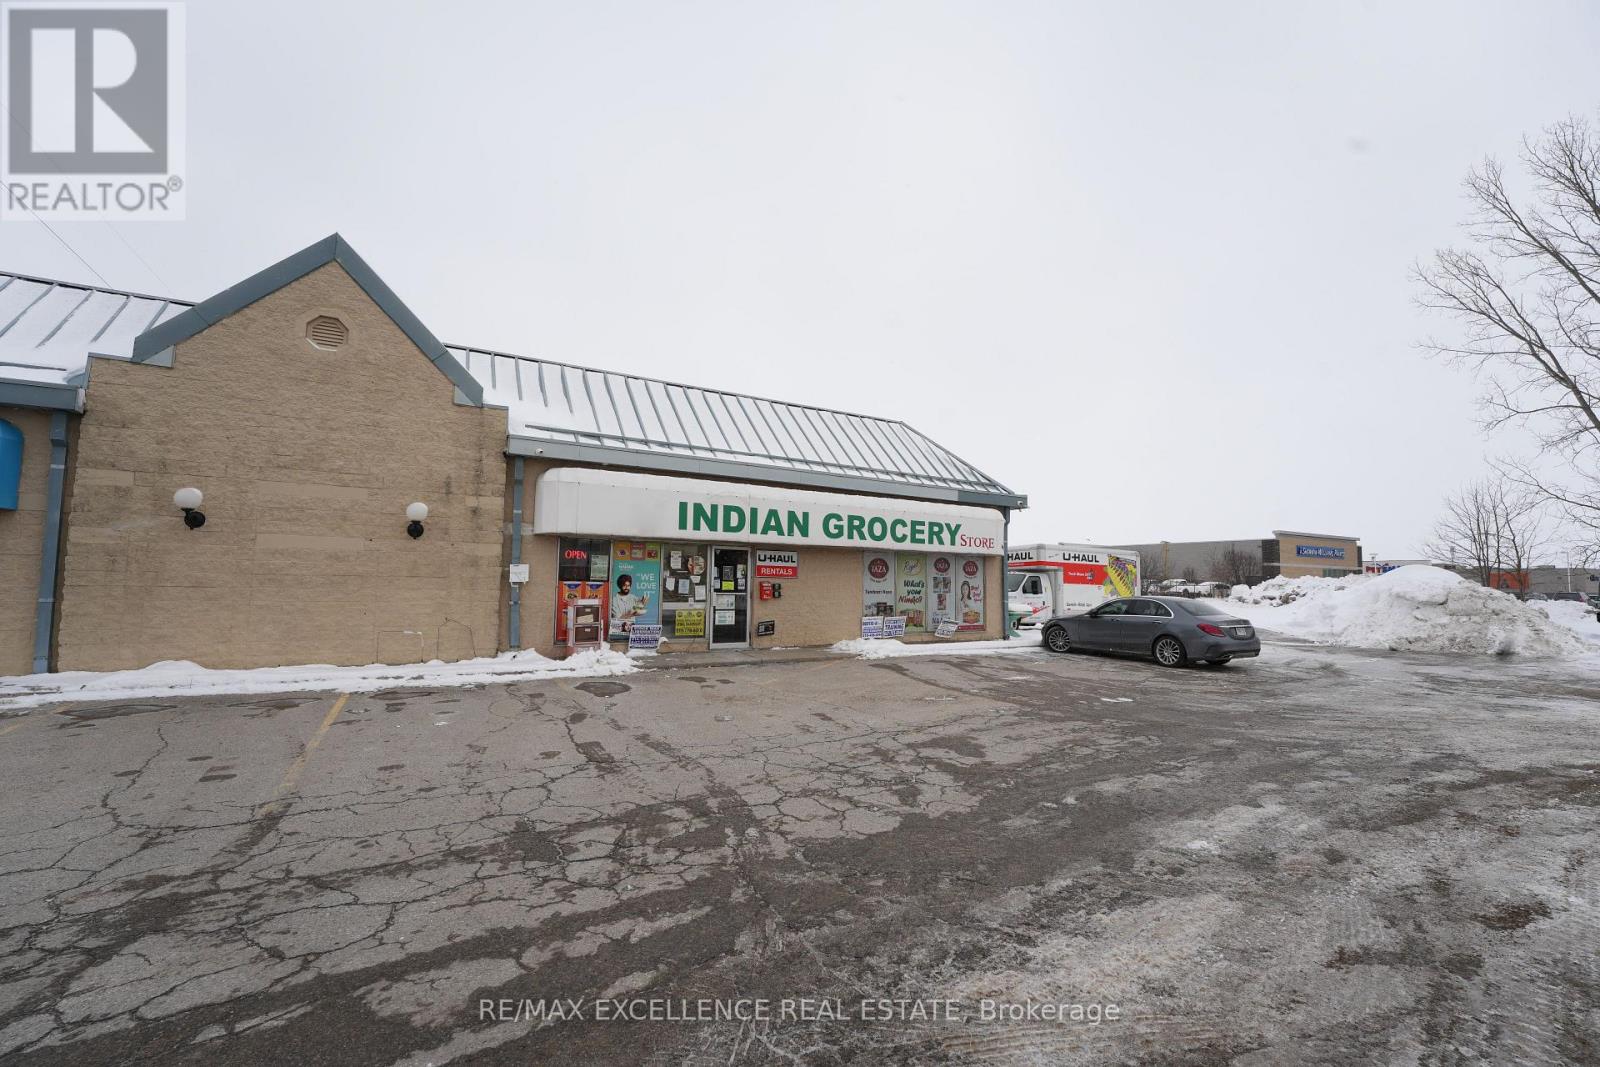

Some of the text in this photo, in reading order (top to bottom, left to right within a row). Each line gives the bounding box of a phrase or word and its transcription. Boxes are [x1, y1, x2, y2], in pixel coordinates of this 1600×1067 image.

[678, 501, 810, 538] INDIAN
[822, 512, 962, 547] GROCERY
[565, 549, 587, 559] OPEN
[758, 553, 796, 564] U-HAUL
[1063, 552, 1100, 563] U-HAUL
[761, 568, 793, 576] RENTALS
[636, 582, 657, 590] LOVE
